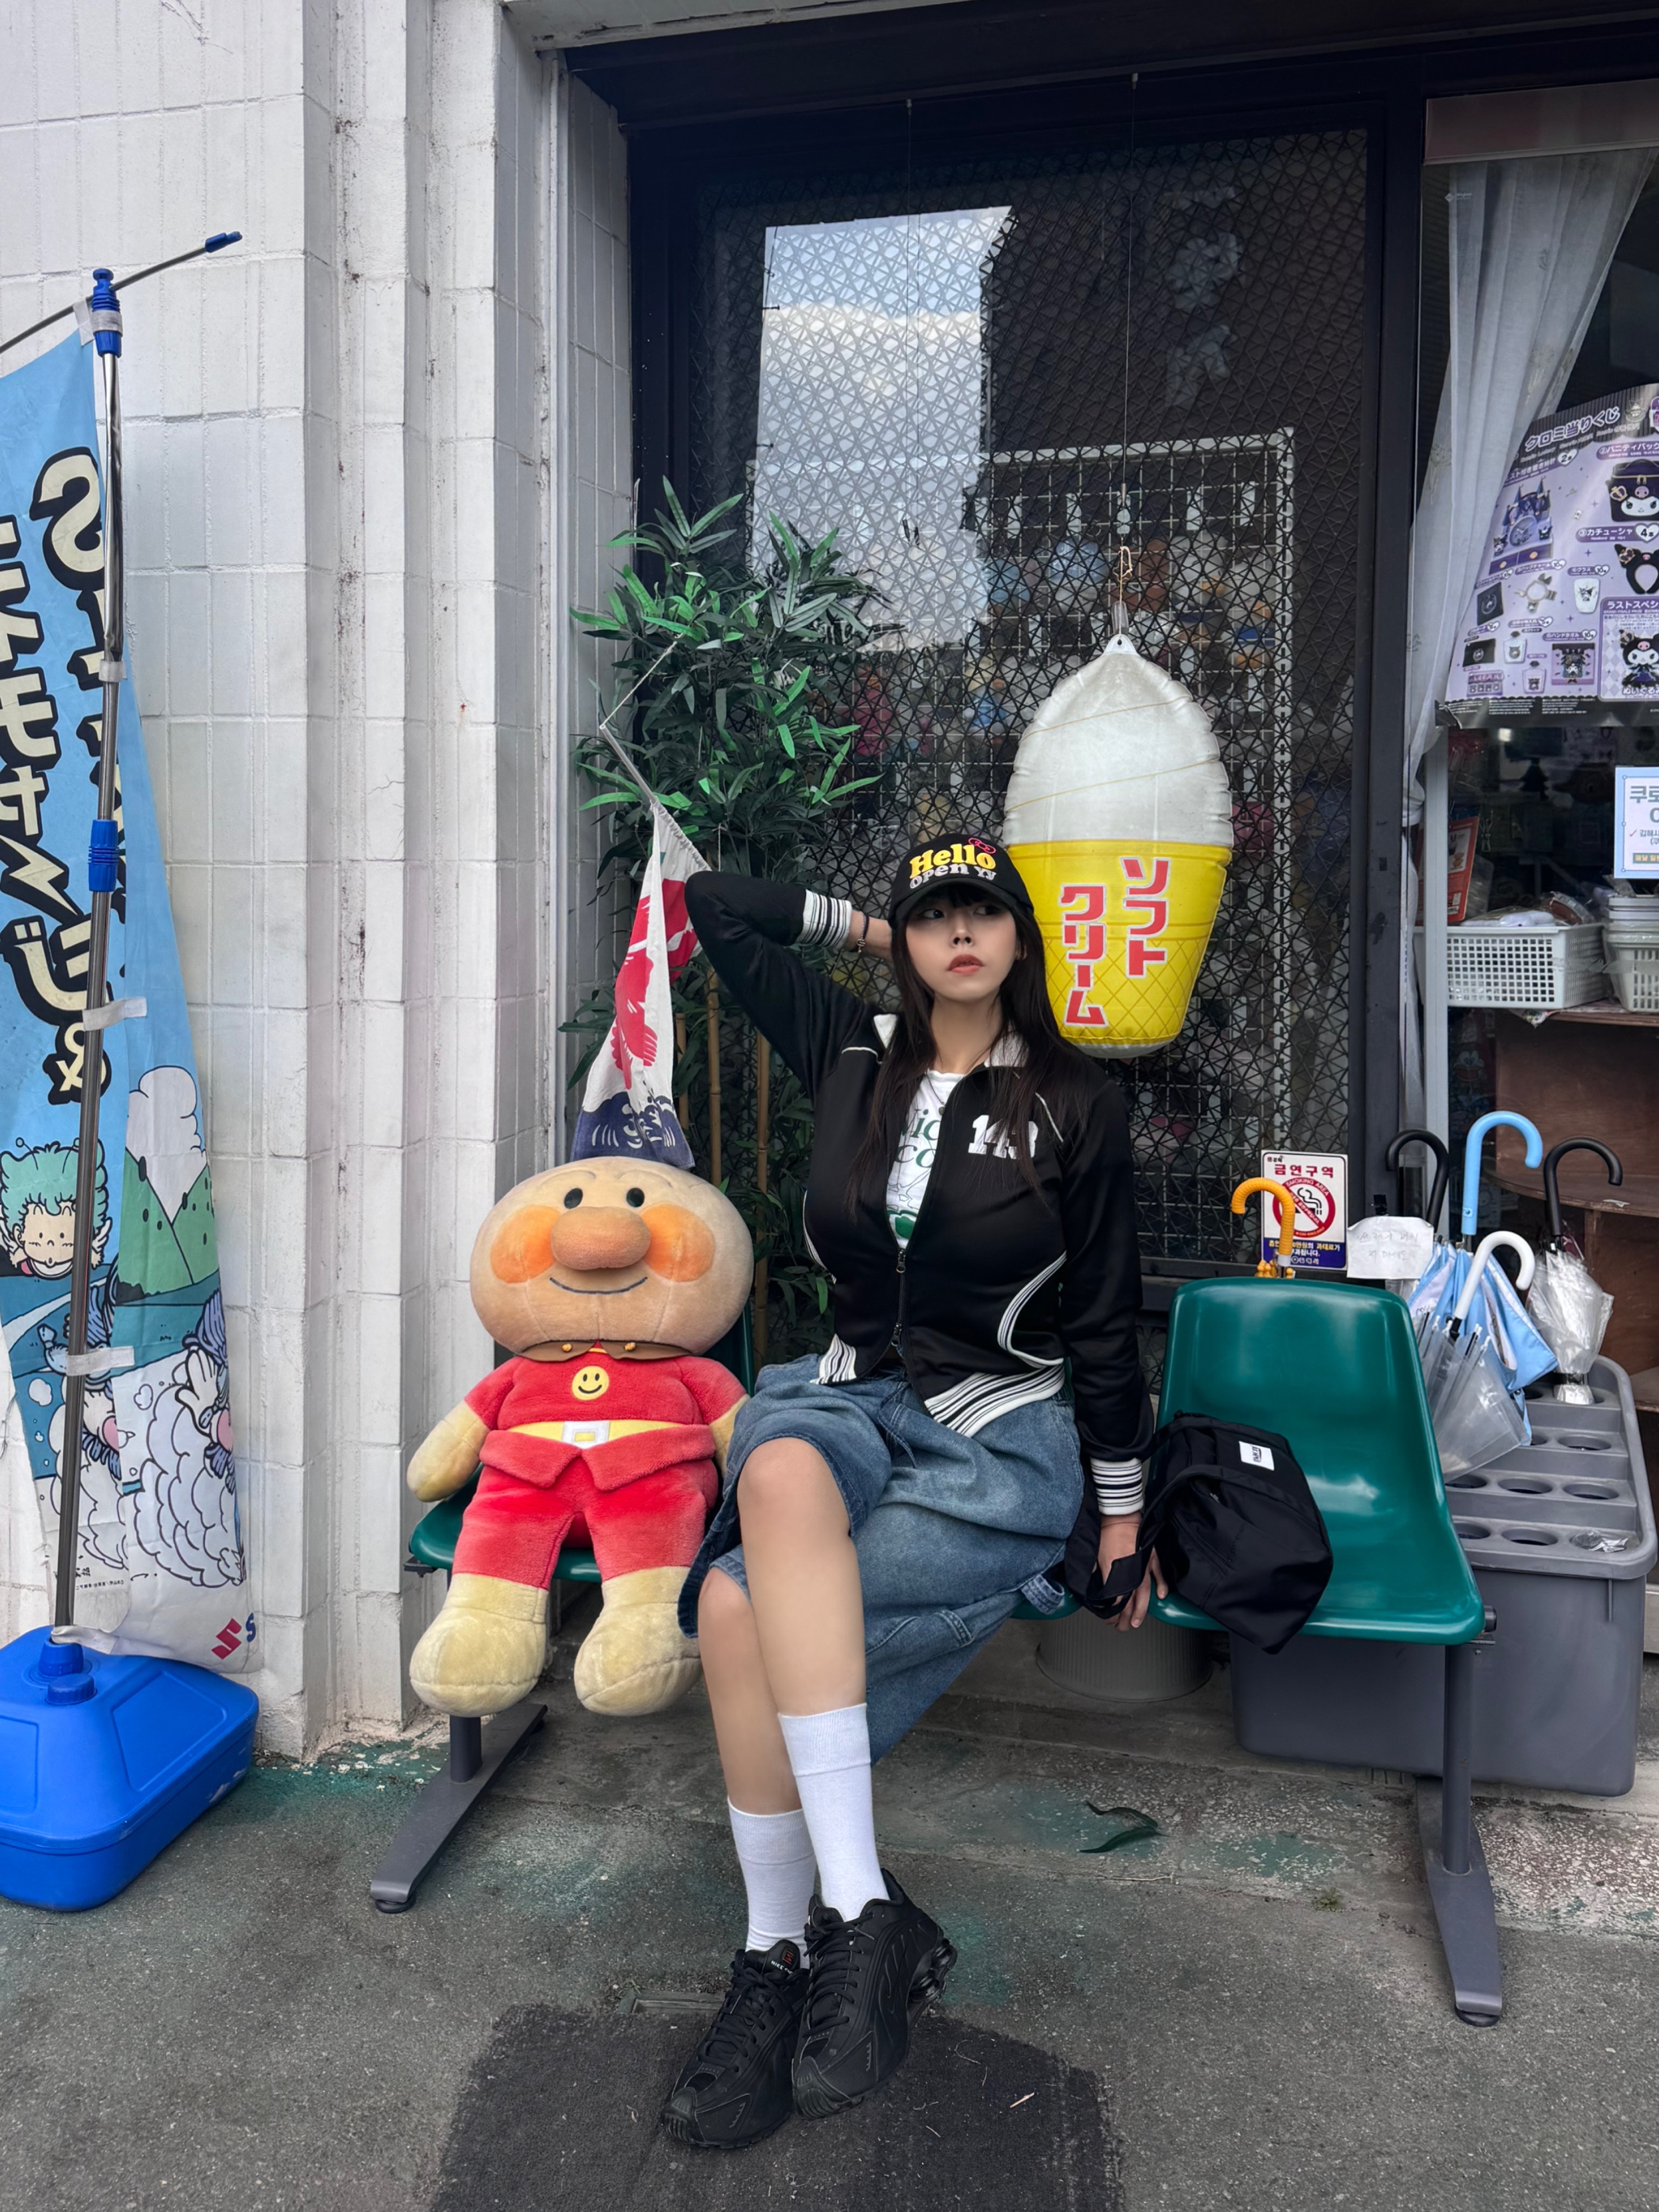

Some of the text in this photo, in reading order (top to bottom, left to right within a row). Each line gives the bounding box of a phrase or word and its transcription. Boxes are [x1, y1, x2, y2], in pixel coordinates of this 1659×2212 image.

[1525, 406, 1620, 452] クロミ当りくじ
[909, 844, 996, 879] Hello
[1120, 856, 1171, 979] ソフト
[1058, 883, 1109, 1027] クリーム
[1275, 1164, 1334, 1178] 금연구역
[1285, 1178, 1330, 1197] SMOKING AREA
[1292, 1248, 1320, 1257] 과됩니다.
